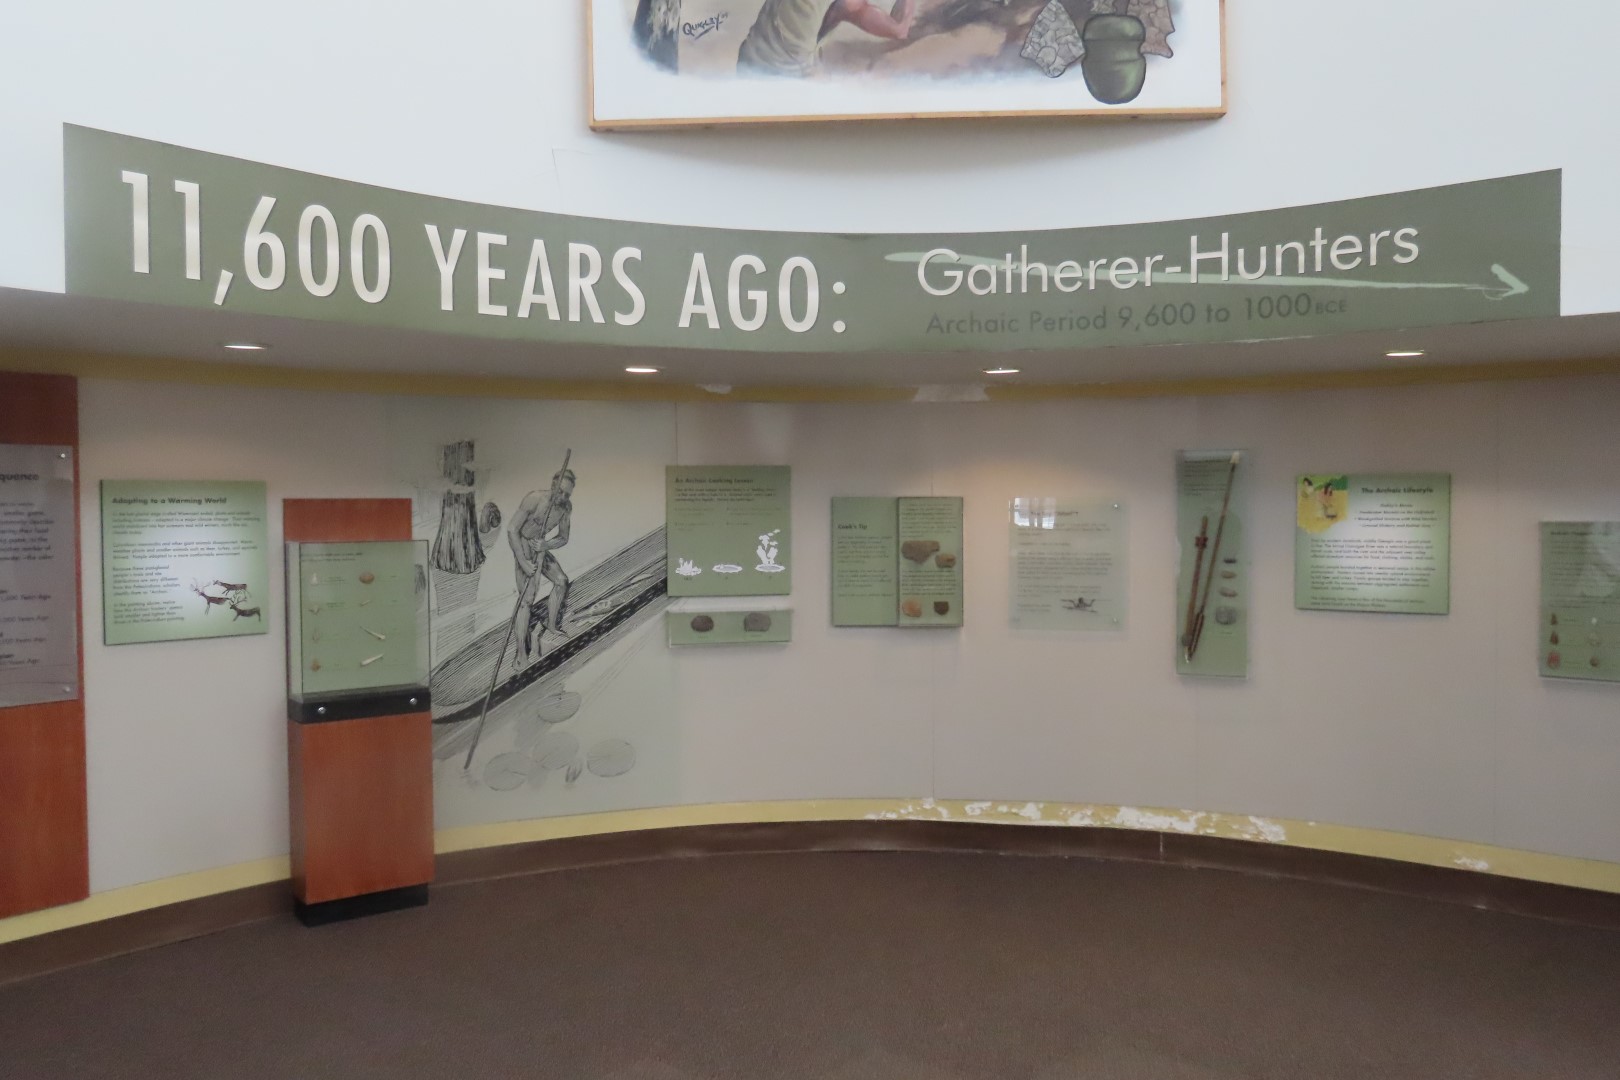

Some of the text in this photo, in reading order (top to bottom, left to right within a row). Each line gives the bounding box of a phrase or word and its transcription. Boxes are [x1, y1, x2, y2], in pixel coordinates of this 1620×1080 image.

[121, 170, 846, 333] 11,600 YEARS AGO:
[917, 227, 1419, 296] Gatherer-Hunters
[926, 293, 1347, 336] Archaic Period 9,600 to 1000 BCE
